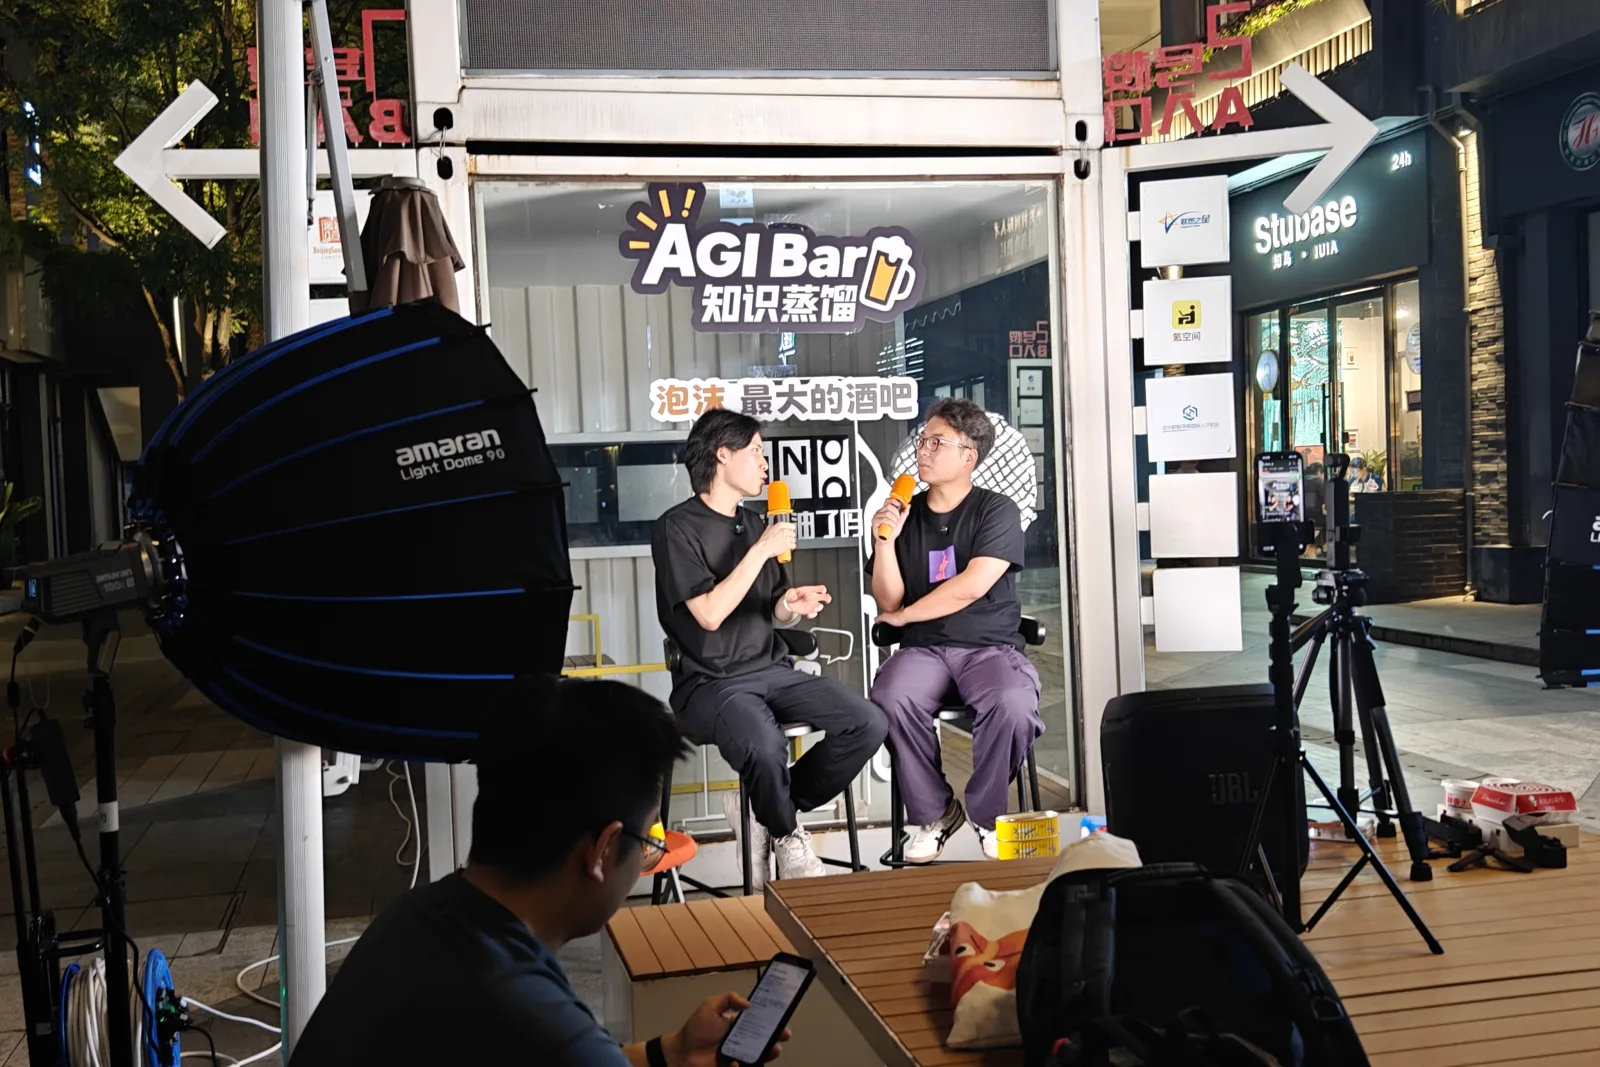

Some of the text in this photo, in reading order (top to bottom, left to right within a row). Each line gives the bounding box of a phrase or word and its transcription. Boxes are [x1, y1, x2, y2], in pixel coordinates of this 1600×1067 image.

[1392, 151, 1412, 171] 24h
[641, 223, 868, 285] AGI Bar
[701, 284, 858, 323] 知识蒸馏
[656, 383, 912, 416] 泡沫 最大的酒吧
[395, 429, 501, 466] amaran
[443, 454, 484, 470] Dome
[486, 448, 505, 461] 90
[766, 509, 863, 540] 油了吗
[1208, 772, 1258, 805] JBL
